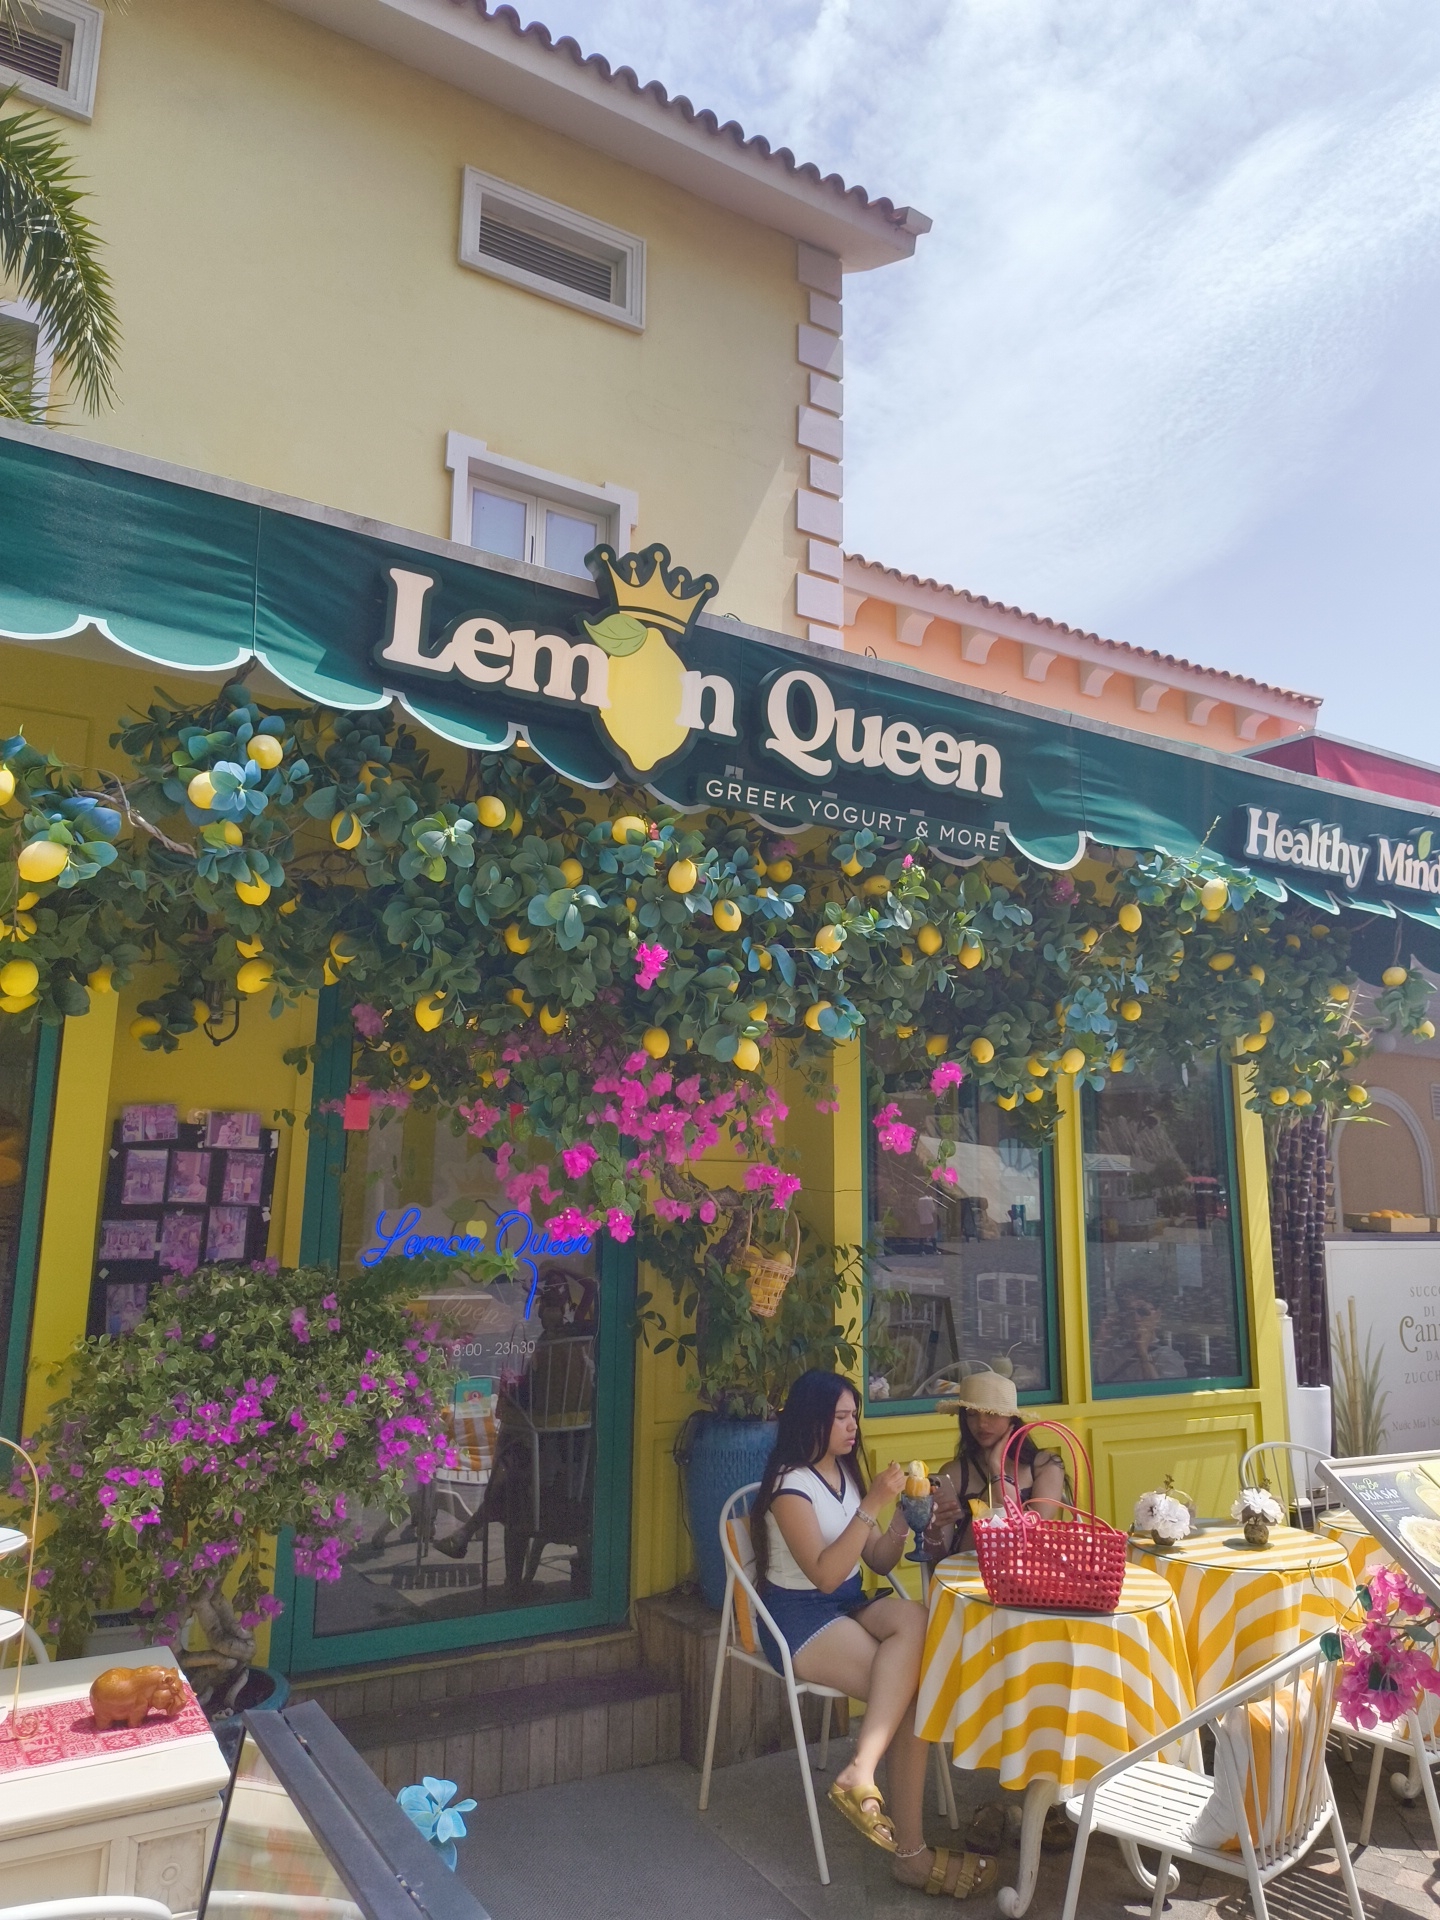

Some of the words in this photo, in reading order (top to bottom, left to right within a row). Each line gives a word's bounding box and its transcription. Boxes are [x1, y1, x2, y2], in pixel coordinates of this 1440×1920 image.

[382, 566, 738, 772] Lemon
[765, 670, 1004, 798] Queen
[705, 779, 797, 812] GREEK
[807, 798, 907, 833] YOGURT
[916, 820, 929, 838] &
[939, 824, 1000, 853] MORE
[1245, 807, 1369, 888] Healthy
[360, 1207, 485, 1268] Lemon
[495, 1209, 593, 1320] Queen
[441, 1292, 503, 1326] Open
[1410, 1285, 1440, 1298] SUCC
[1423, 1305, 1435, 1317] DI
[453, 1342, 482, 1357] 8:00
[494, 1340, 536, 1355] 23h30
[1399, 1315, 1440, 1353] Can
